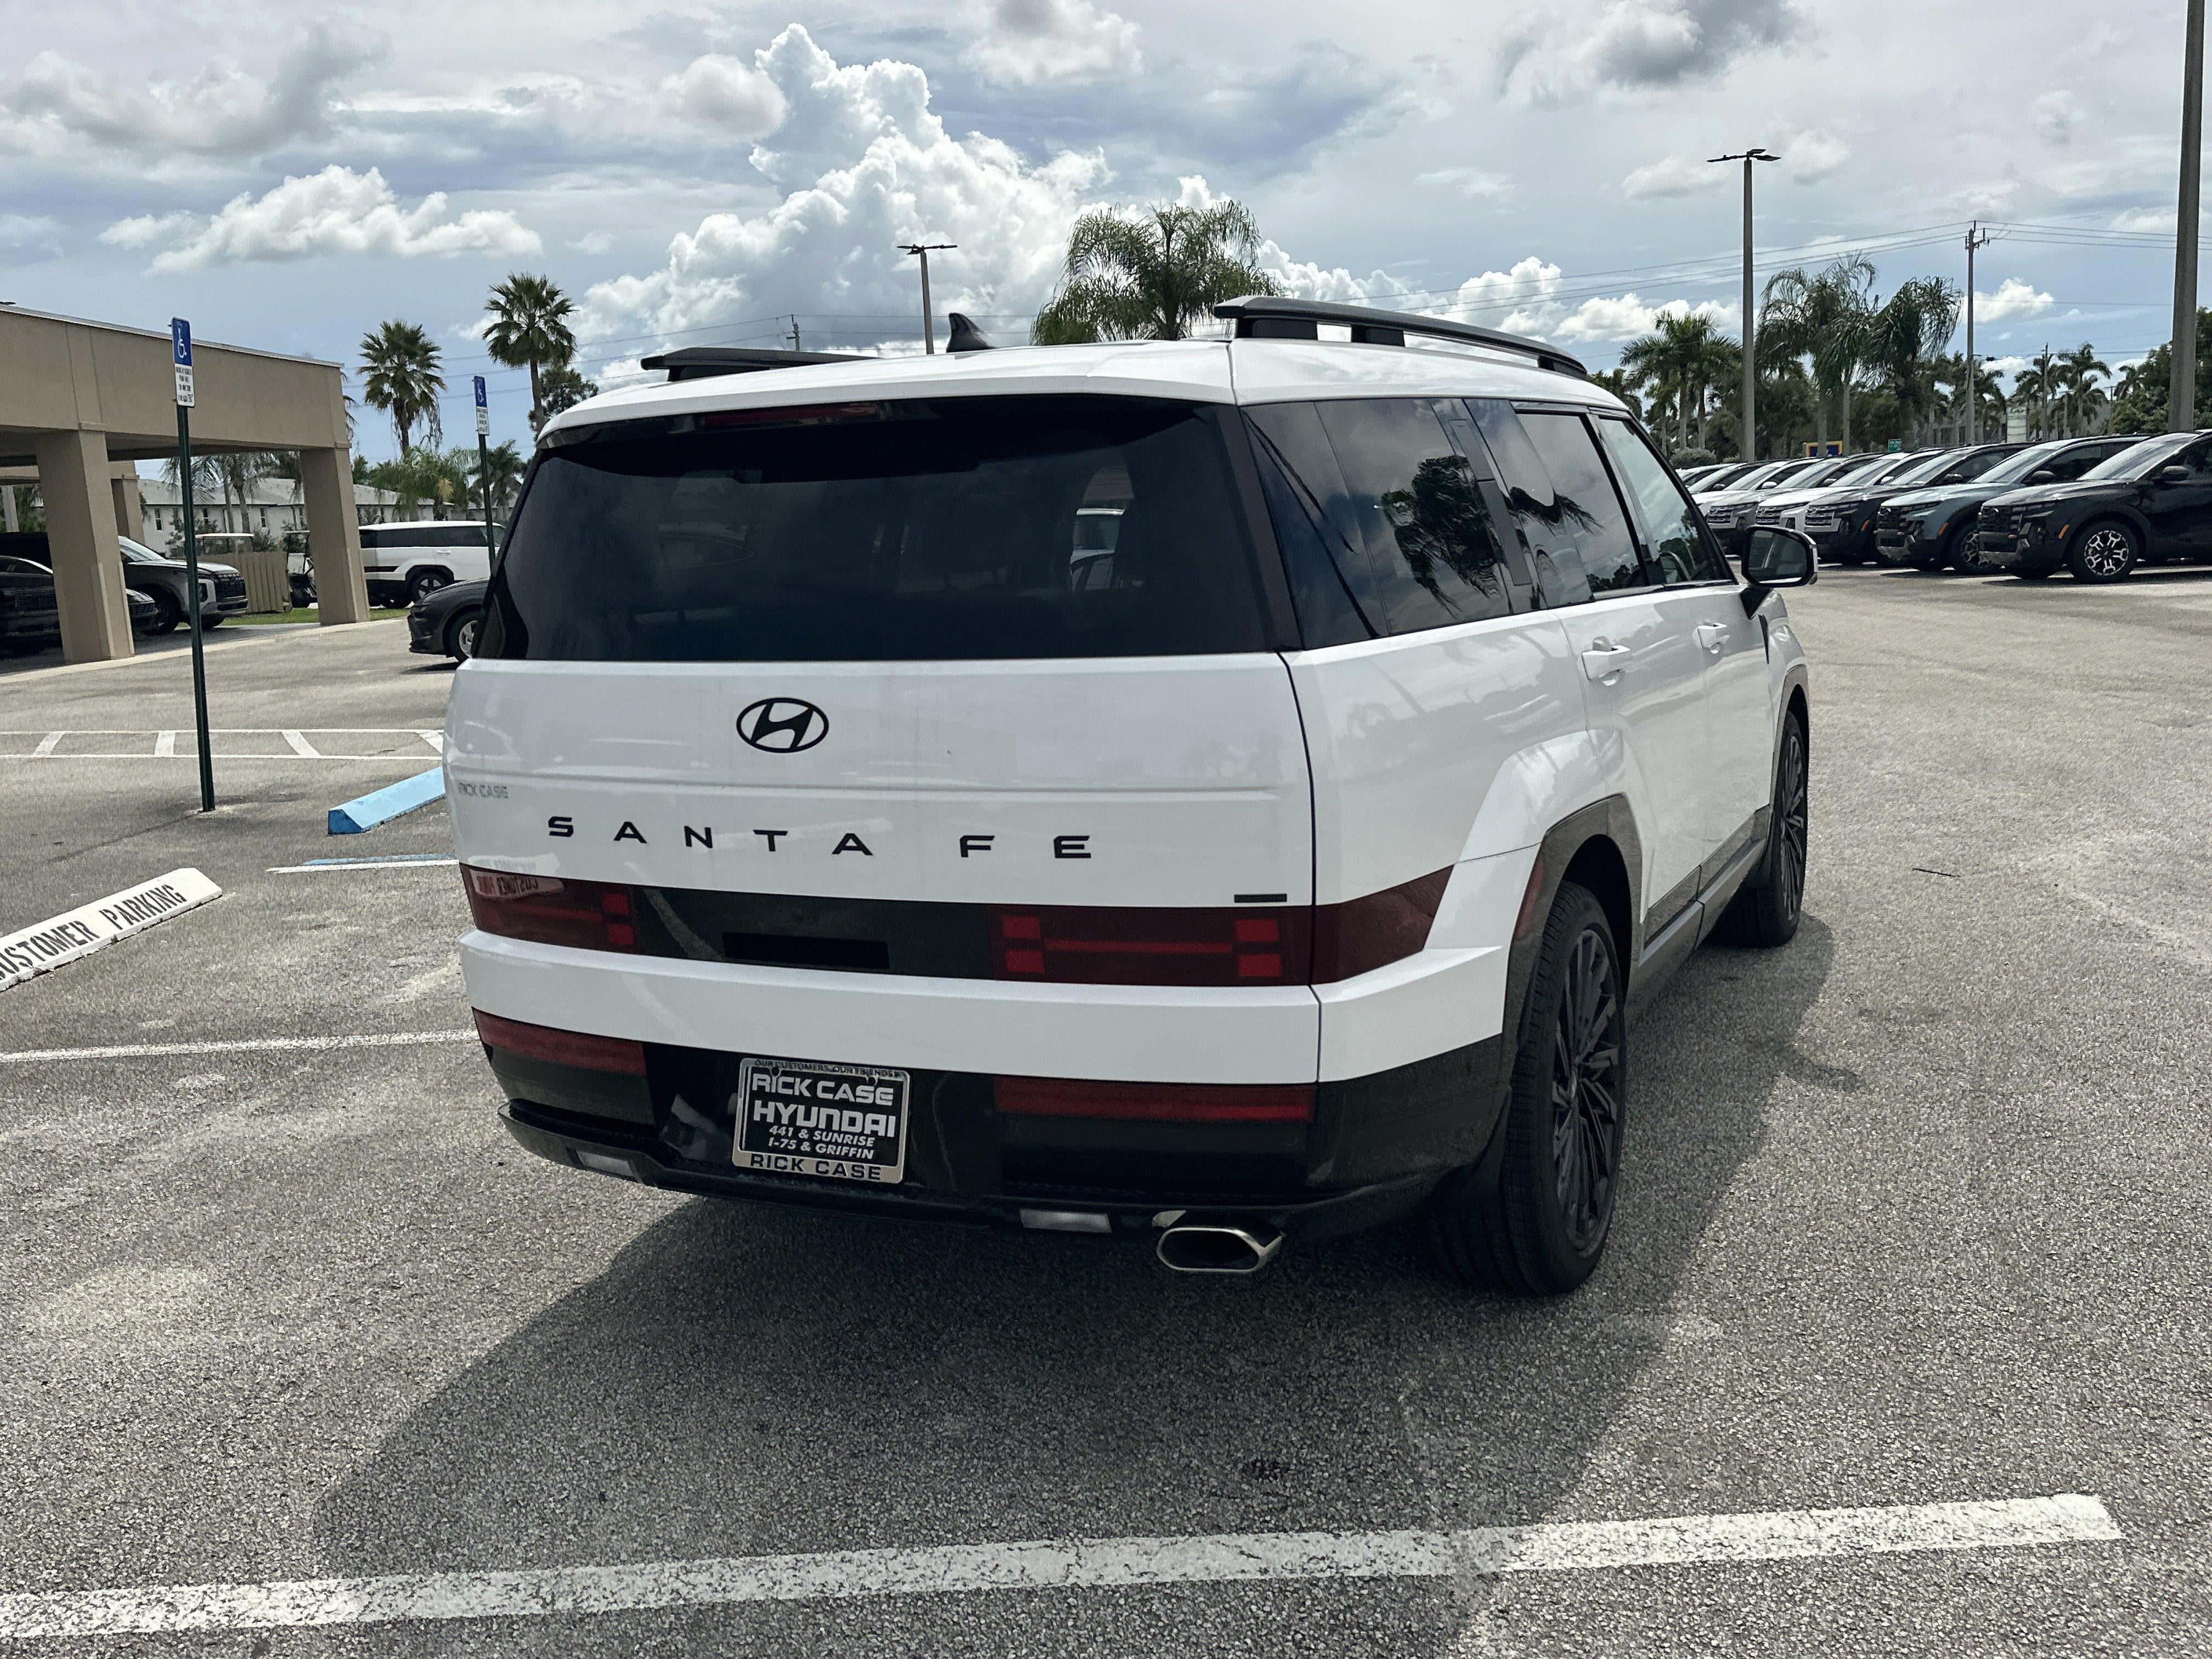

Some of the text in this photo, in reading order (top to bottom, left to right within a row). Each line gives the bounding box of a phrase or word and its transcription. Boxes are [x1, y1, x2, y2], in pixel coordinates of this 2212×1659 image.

[548, 816, 1091, 859] SANTA FE
[0, 884, 187, 981] USTOMER PARKING
[752, 1073, 894, 1106] RICK CASE
[753, 1100, 896, 1137] HYUNDAI
[768, 1137, 874, 1160] I-75 & GRIFFIN
[769, 1125, 876, 1147] 441 & SUNRISE
[751, 1154, 882, 1180] RICK CASE
